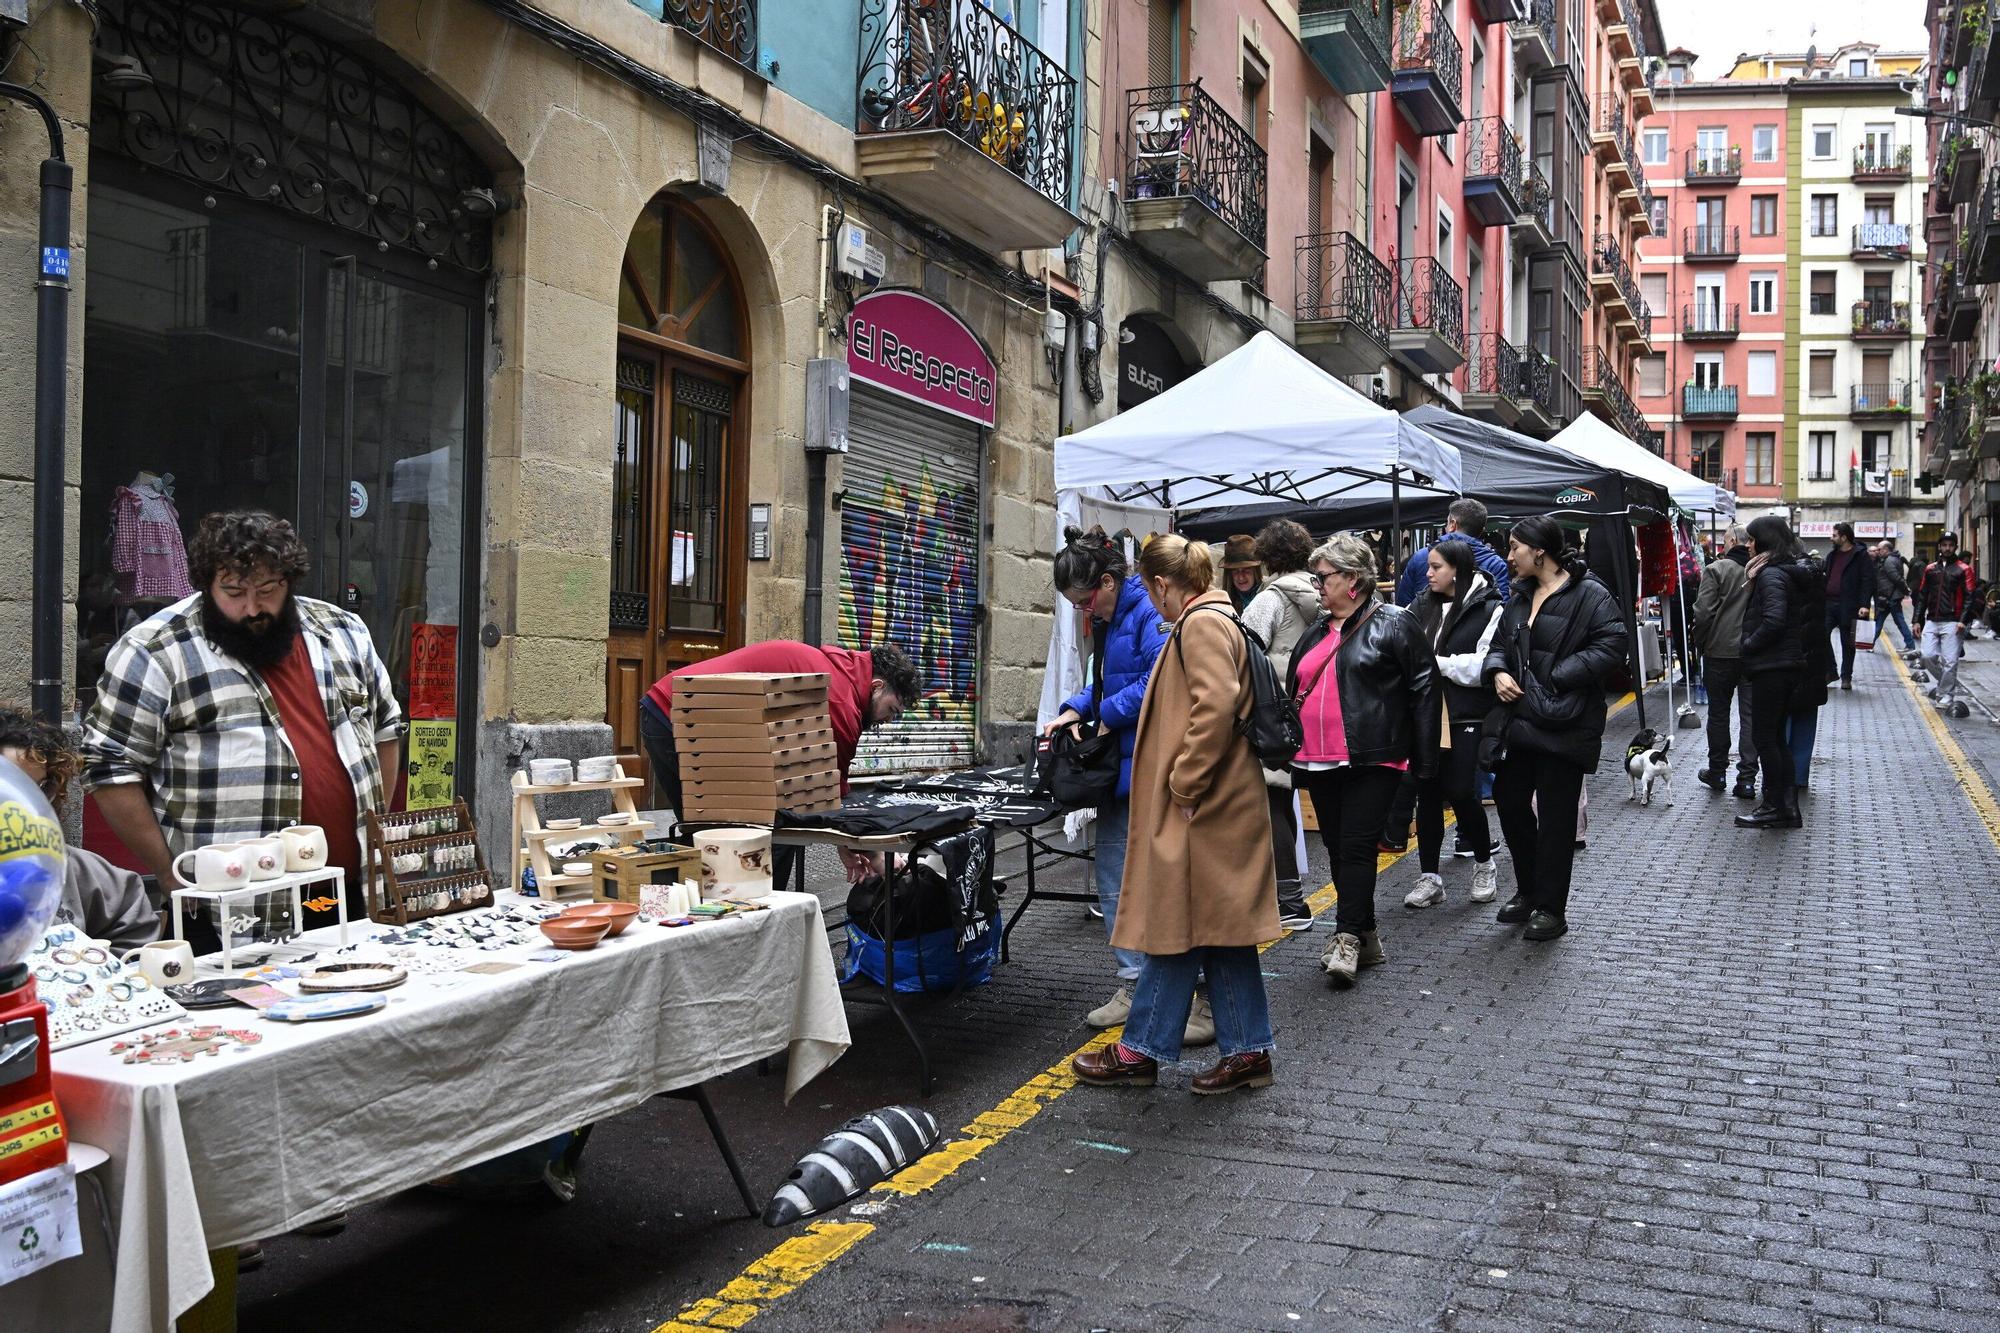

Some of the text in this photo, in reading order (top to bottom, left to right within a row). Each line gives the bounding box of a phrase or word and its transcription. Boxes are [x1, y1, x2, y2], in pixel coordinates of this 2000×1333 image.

[852, 319, 993, 407] El Respecto
[1556, 493, 1592, 504] COBIZI
[415, 727, 452, 737] SORTEO CESTA
[418, 739, 448, 748] DE NAVIDAD
